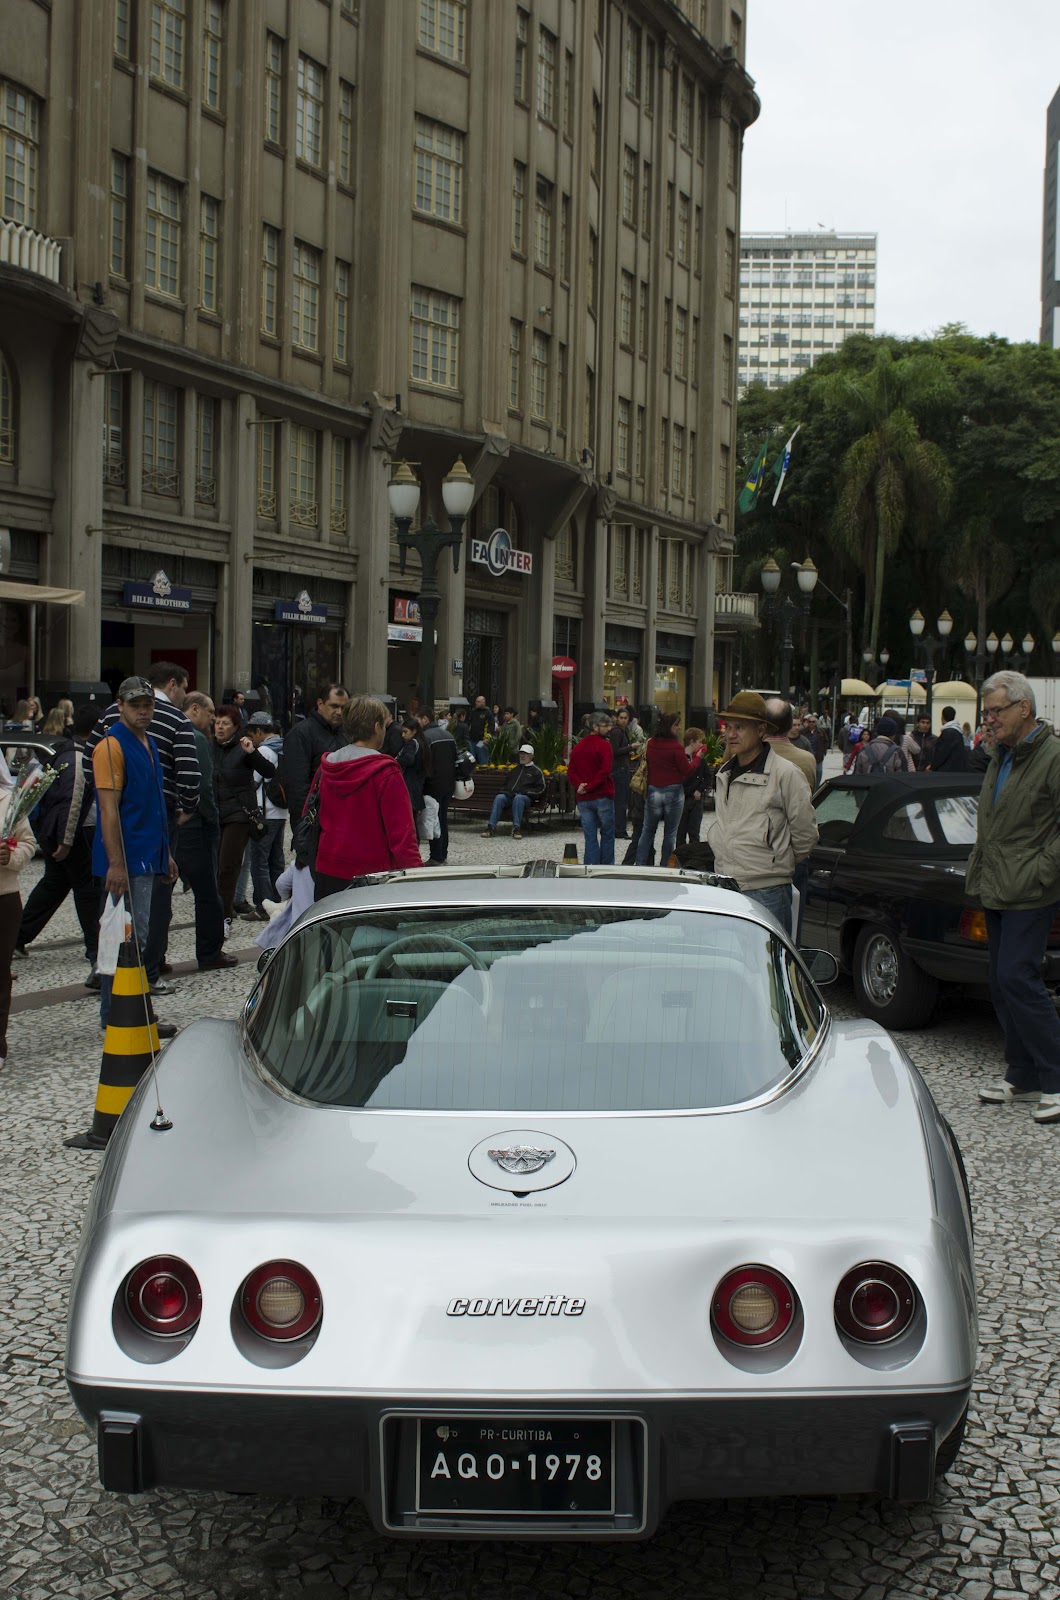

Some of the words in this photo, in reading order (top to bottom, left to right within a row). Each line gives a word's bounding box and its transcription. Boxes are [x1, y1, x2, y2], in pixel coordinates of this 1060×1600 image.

[132, 594, 154, 605] BILLIE
[155, 597, 190, 609] BROTHERS
[282, 612, 299, 621] BILLIE
[299, 614, 326, 624] BROTHERS
[446, 1295, 586, 1317] corvette
